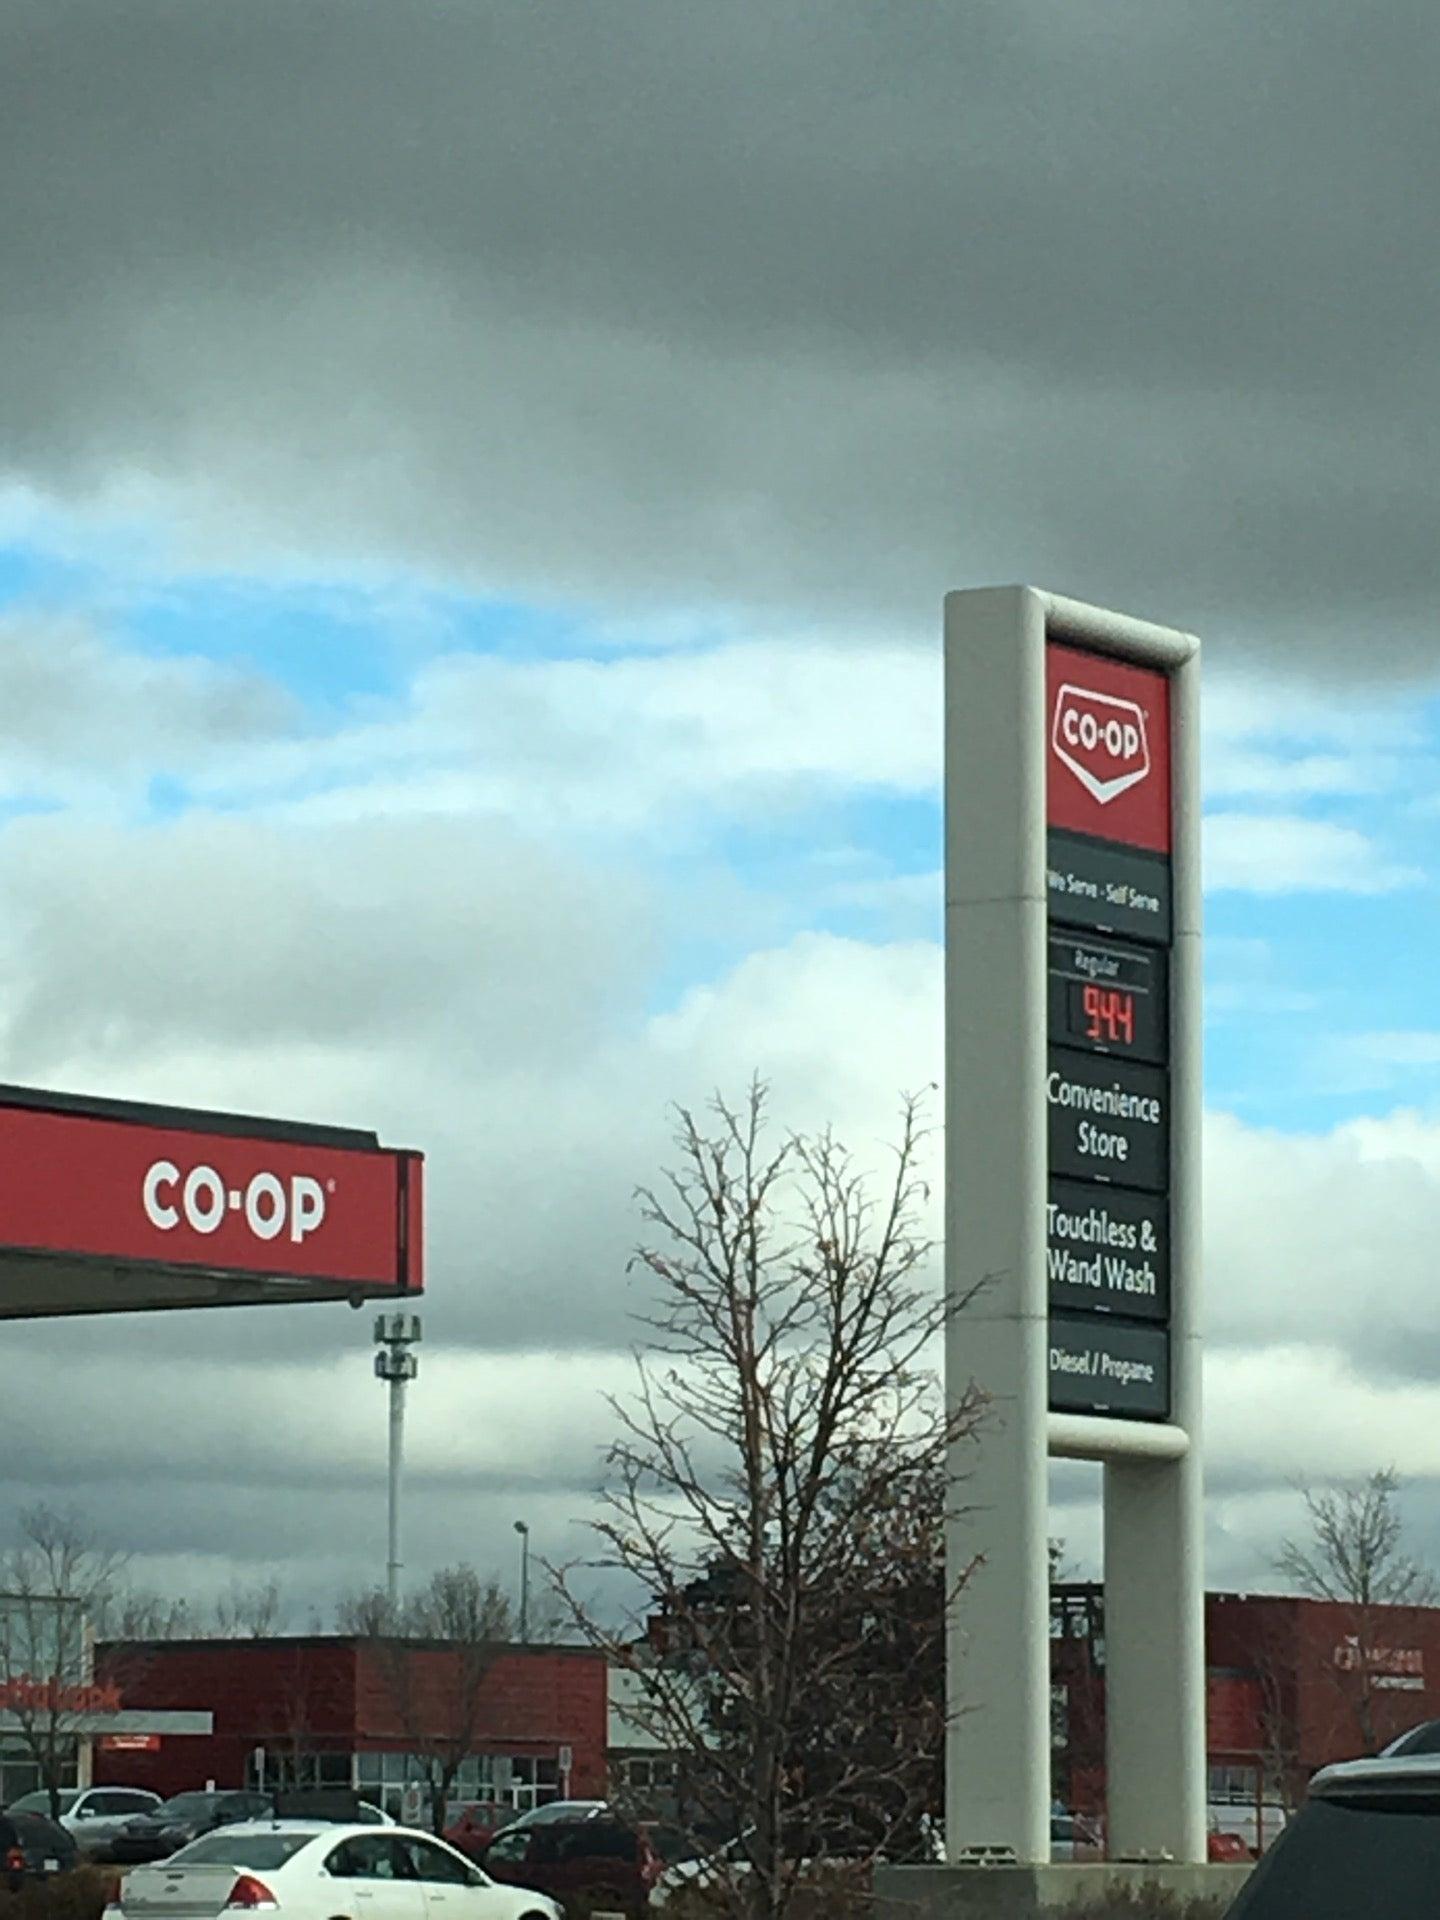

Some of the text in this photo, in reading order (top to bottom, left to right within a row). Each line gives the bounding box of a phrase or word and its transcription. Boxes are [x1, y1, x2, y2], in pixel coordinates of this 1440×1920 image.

[1062, 708, 1139, 760] CO-OP
[1075, 950, 1120, 977] Regular
[1047, 1072, 1160, 1124] Convenience
[1077, 1120, 1128, 1161] Store
[143, 1160, 325, 1243] CO-OP
[1047, 1203, 1157, 1252] Touchless &
[1047, 1248, 1156, 1295] Wand Wash
[1050, 1348, 1089, 1375] Diesel
[1101, 1352, 1154, 1385] Propane
